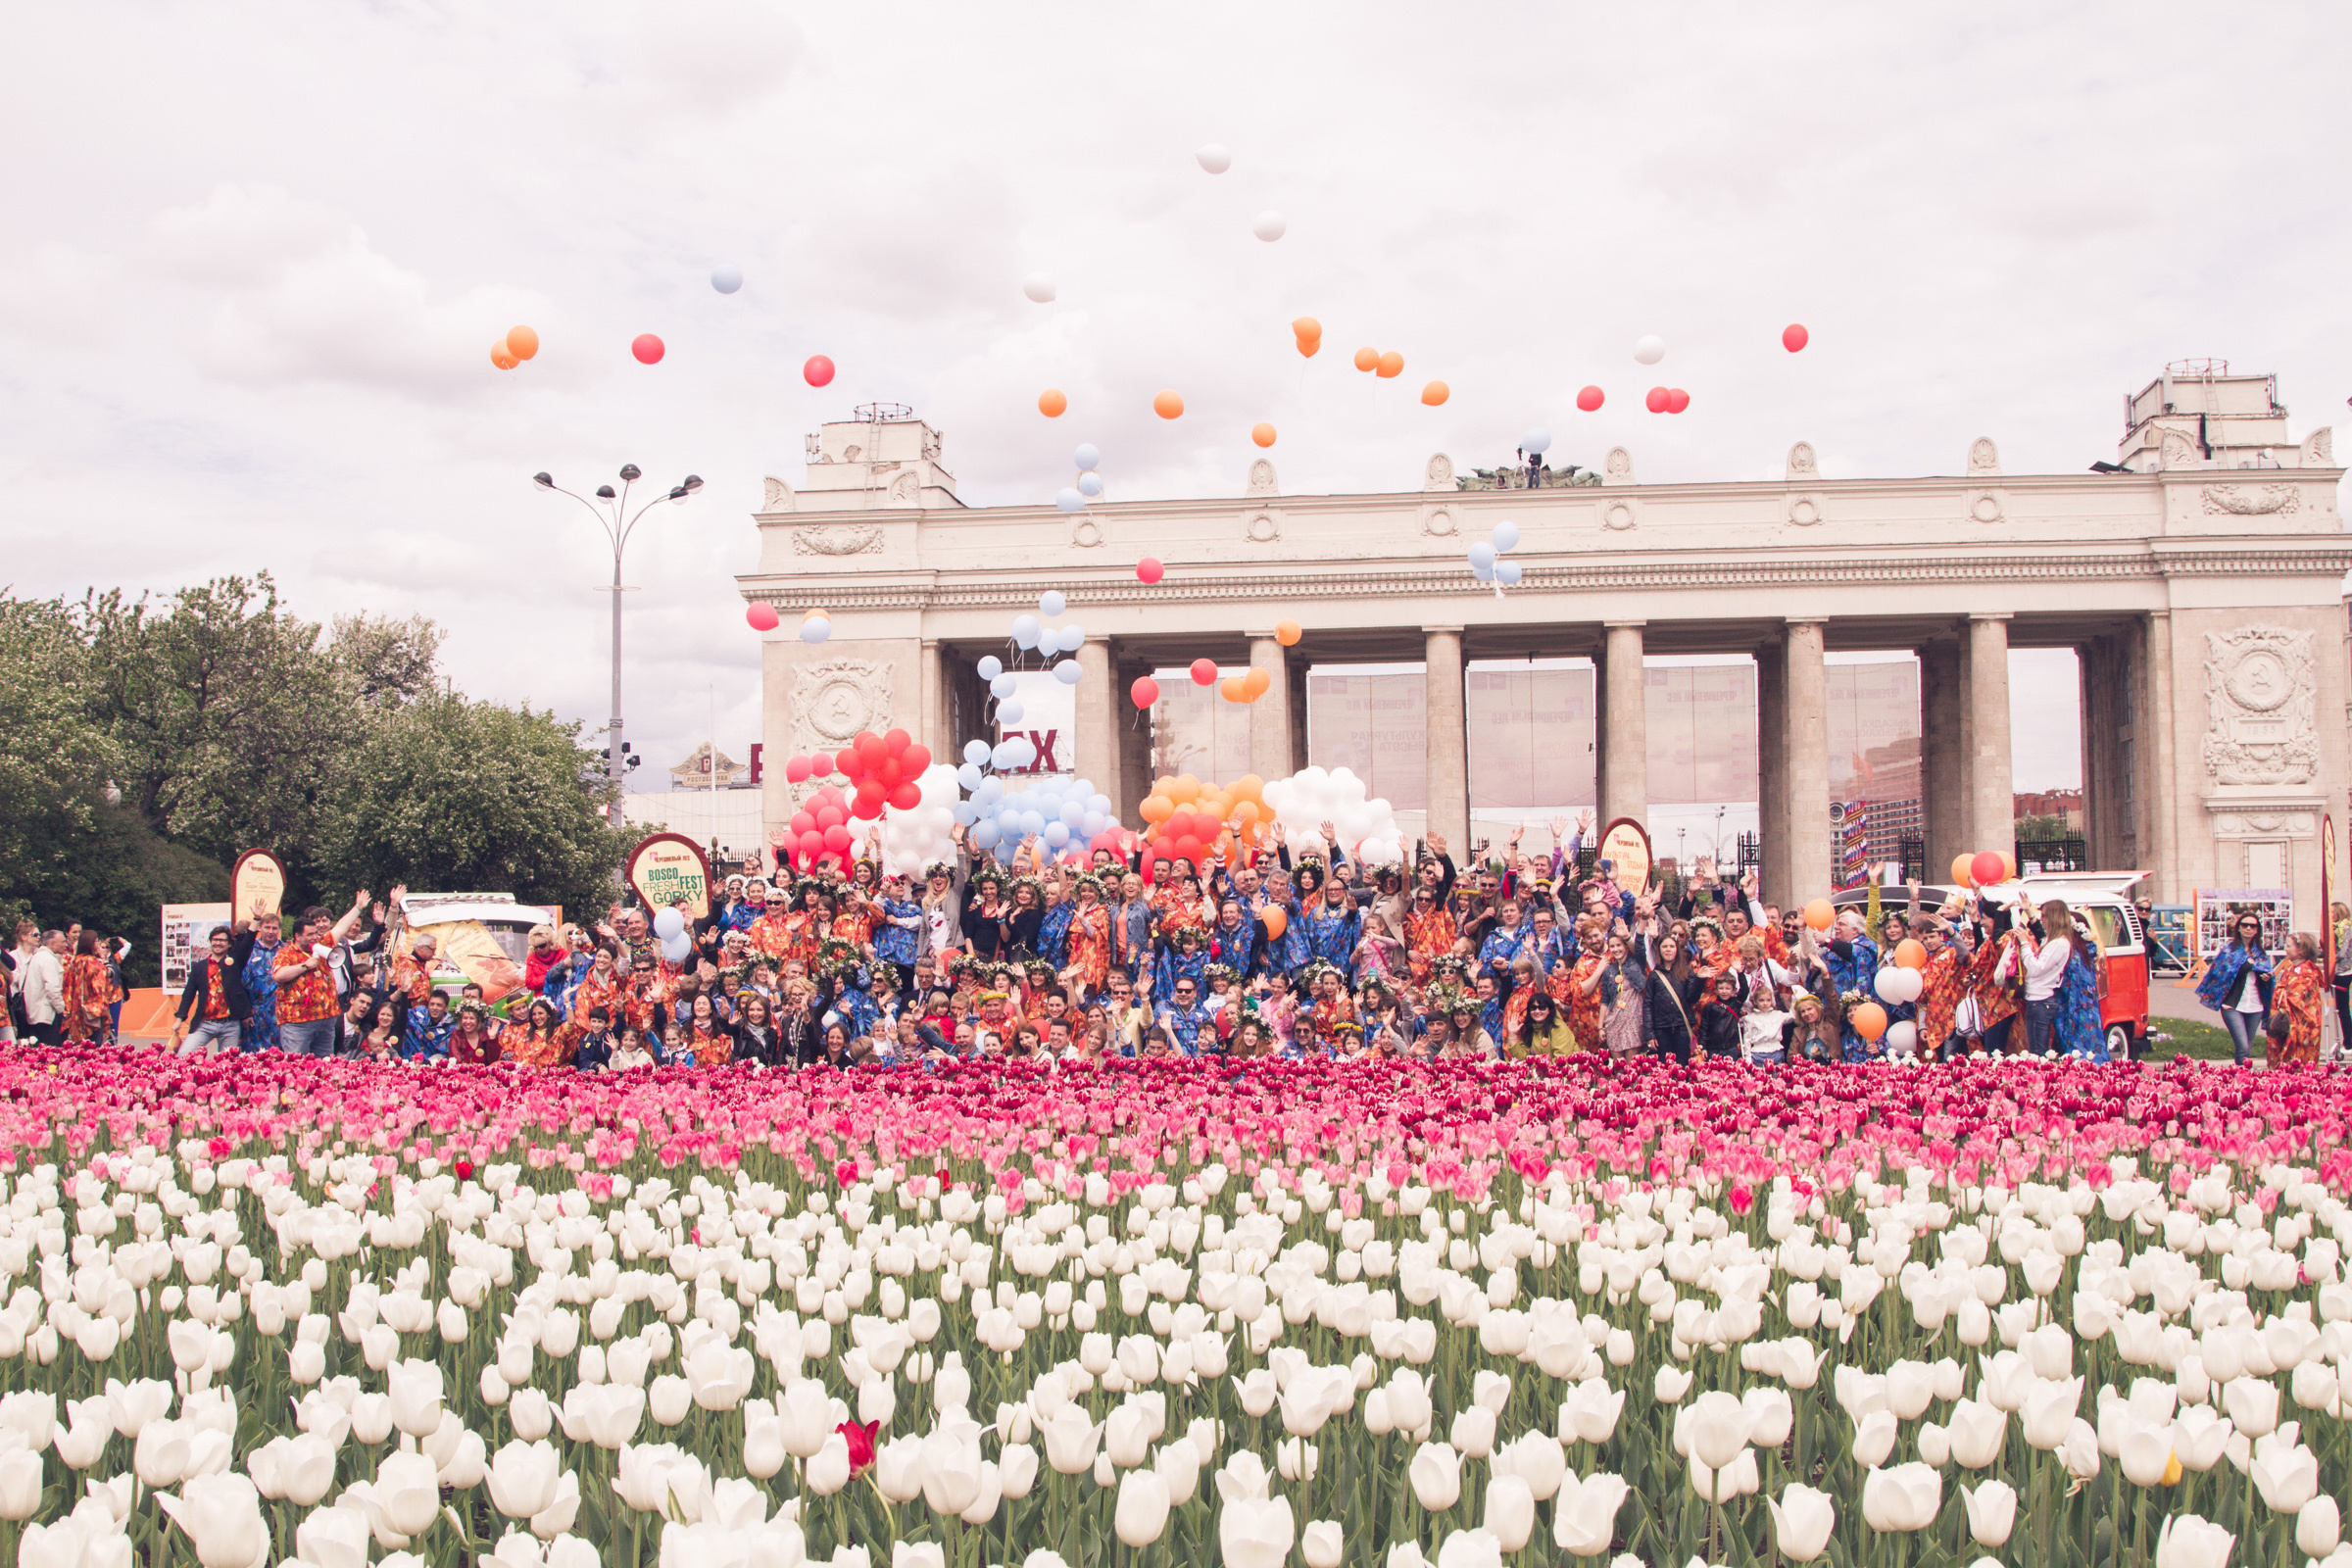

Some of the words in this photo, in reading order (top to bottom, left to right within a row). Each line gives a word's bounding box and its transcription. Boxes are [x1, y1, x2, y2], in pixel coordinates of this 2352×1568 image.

[649, 867, 678, 881] BOSCO
[643, 880, 679, 893] FRESH
[679, 875, 703, 890] FEST
[653, 890, 703, 904] GORKY
